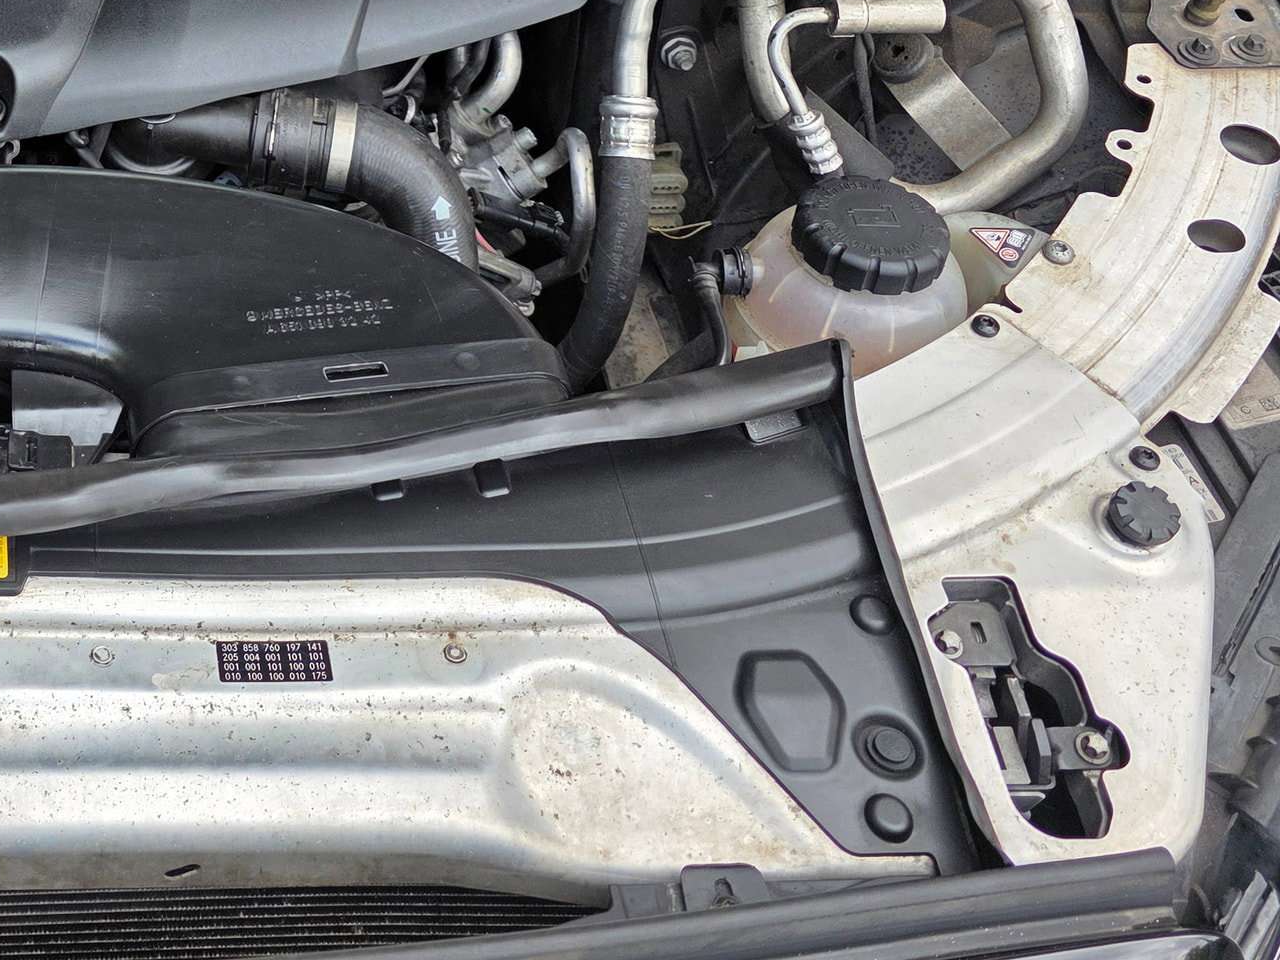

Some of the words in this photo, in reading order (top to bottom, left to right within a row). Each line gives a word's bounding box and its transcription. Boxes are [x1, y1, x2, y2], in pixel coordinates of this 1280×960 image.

[222, 644, 238, 652] 303
[243, 644, 258, 652] 858
[264, 644, 280, 652] 760
[286, 643, 300, 651] 197
[307, 643, 321, 651] 141
[223, 654, 238, 662] 205
[244, 653, 259, 661] 004
[265, 653, 280, 661] 001
[288, 653, 302, 661] 101
[309, 652, 323, 660] 101
[224, 663, 239, 671] 001
[245, 663, 260, 671] 001
[268, 663, 282, 671] 101
[289, 662, 304, 670] 100
[309, 662, 325, 670] 010
[289, 672, 305, 680] 010
[312, 672, 327, 680] 175
